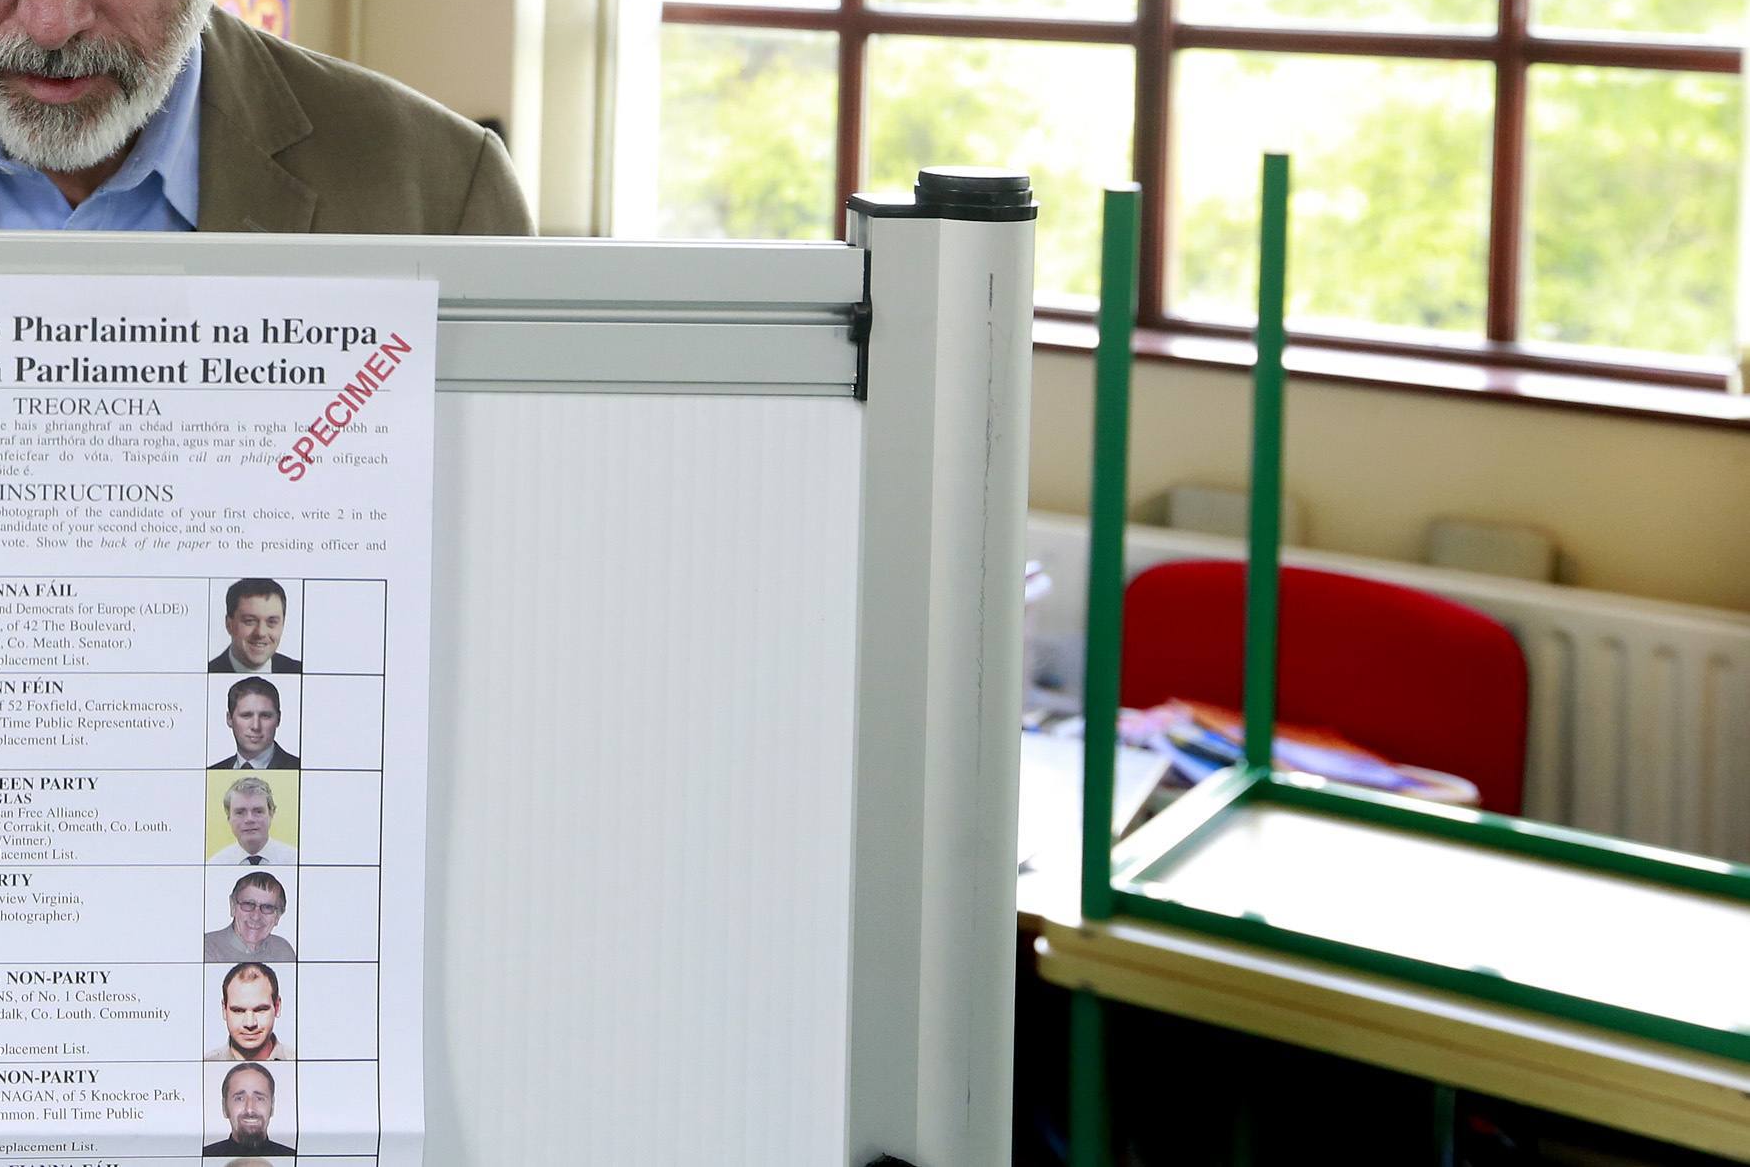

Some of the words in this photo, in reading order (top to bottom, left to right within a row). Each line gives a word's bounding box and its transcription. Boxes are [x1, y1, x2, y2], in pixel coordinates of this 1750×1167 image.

[12, 315, 201, 344] Pharlaimint
[212, 324, 249, 344] na
[260, 317, 378, 352] hEorpa
[14, 355, 188, 384] Parliament
[199, 357, 326, 385] Election
[12, 396, 162, 416] TREORACHA
[277, 332, 413, 482] SPECIMEN
[0, 482, 173, 502] INSTRUCTIONS
[51, 519, 65, 532] of
[67, 522, 95, 536] your
[96, 520, 137, 533] second
[139, 520, 182, 534] choice,
[184, 520, 206, 534] and
[208, 523, 223, 534] so
[225, 524, 245, 534] on.
[35, 579, 77, 597] FÁIL
[5, 618, 21, 632] of
[22, 618, 38, 632] 42
[40, 618, 65, 632] The
[21, 676, 64, 694] FÉIN
[7, 698, 22, 712] 52
[34, 715, 73, 729] Public
[77, 715, 174, 732] Representative.)
[39, 776, 98, 790] PARTY
[6, 970, 111, 985] NON-PARTY
[98, 1006, 171, 1022] Community
